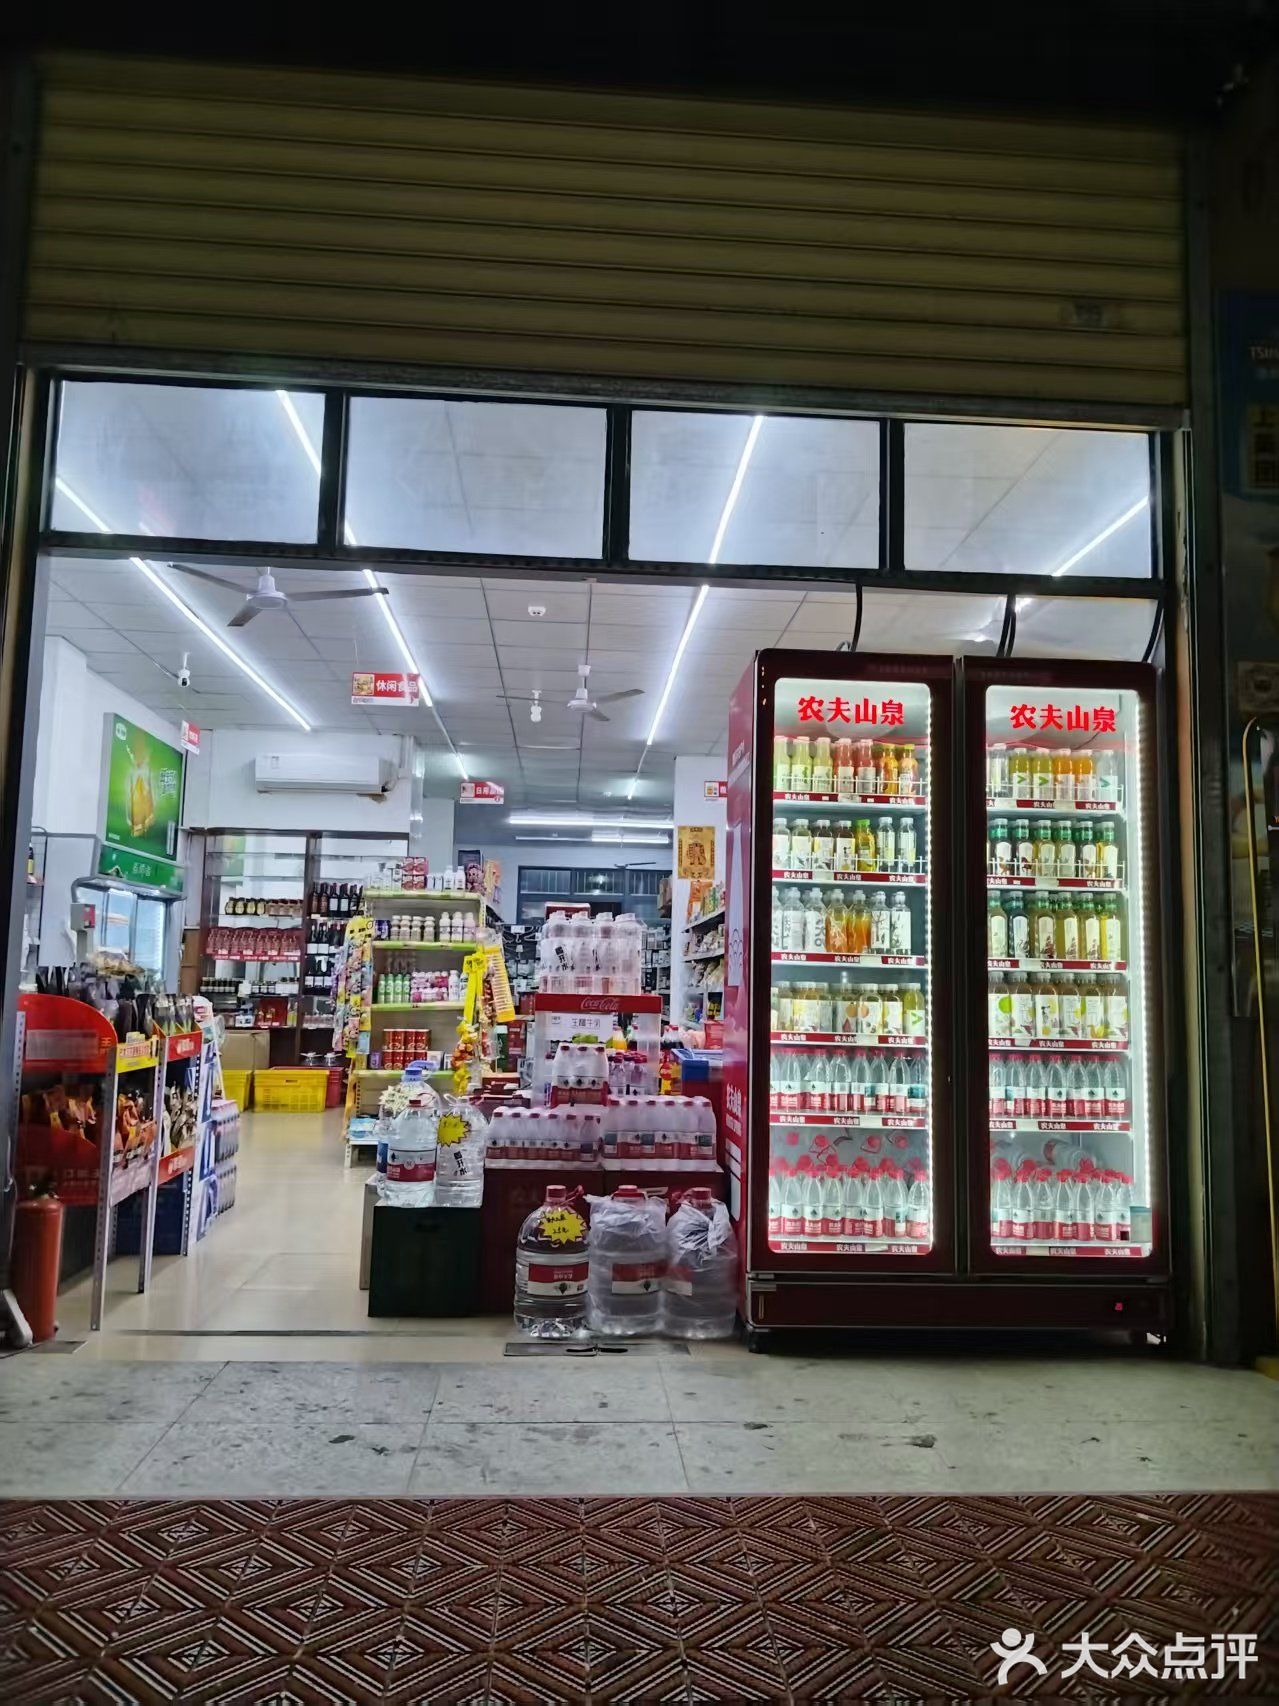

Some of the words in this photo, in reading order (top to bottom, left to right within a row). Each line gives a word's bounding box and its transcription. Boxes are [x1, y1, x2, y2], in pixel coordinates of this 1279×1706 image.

[376, 679, 418, 693] 休闲食品
[797, 695, 905, 726] 农夫山泉
[1010, 703, 1117, 732] 农夫山泉
[834, 1035, 857, 1043] 农夫山
